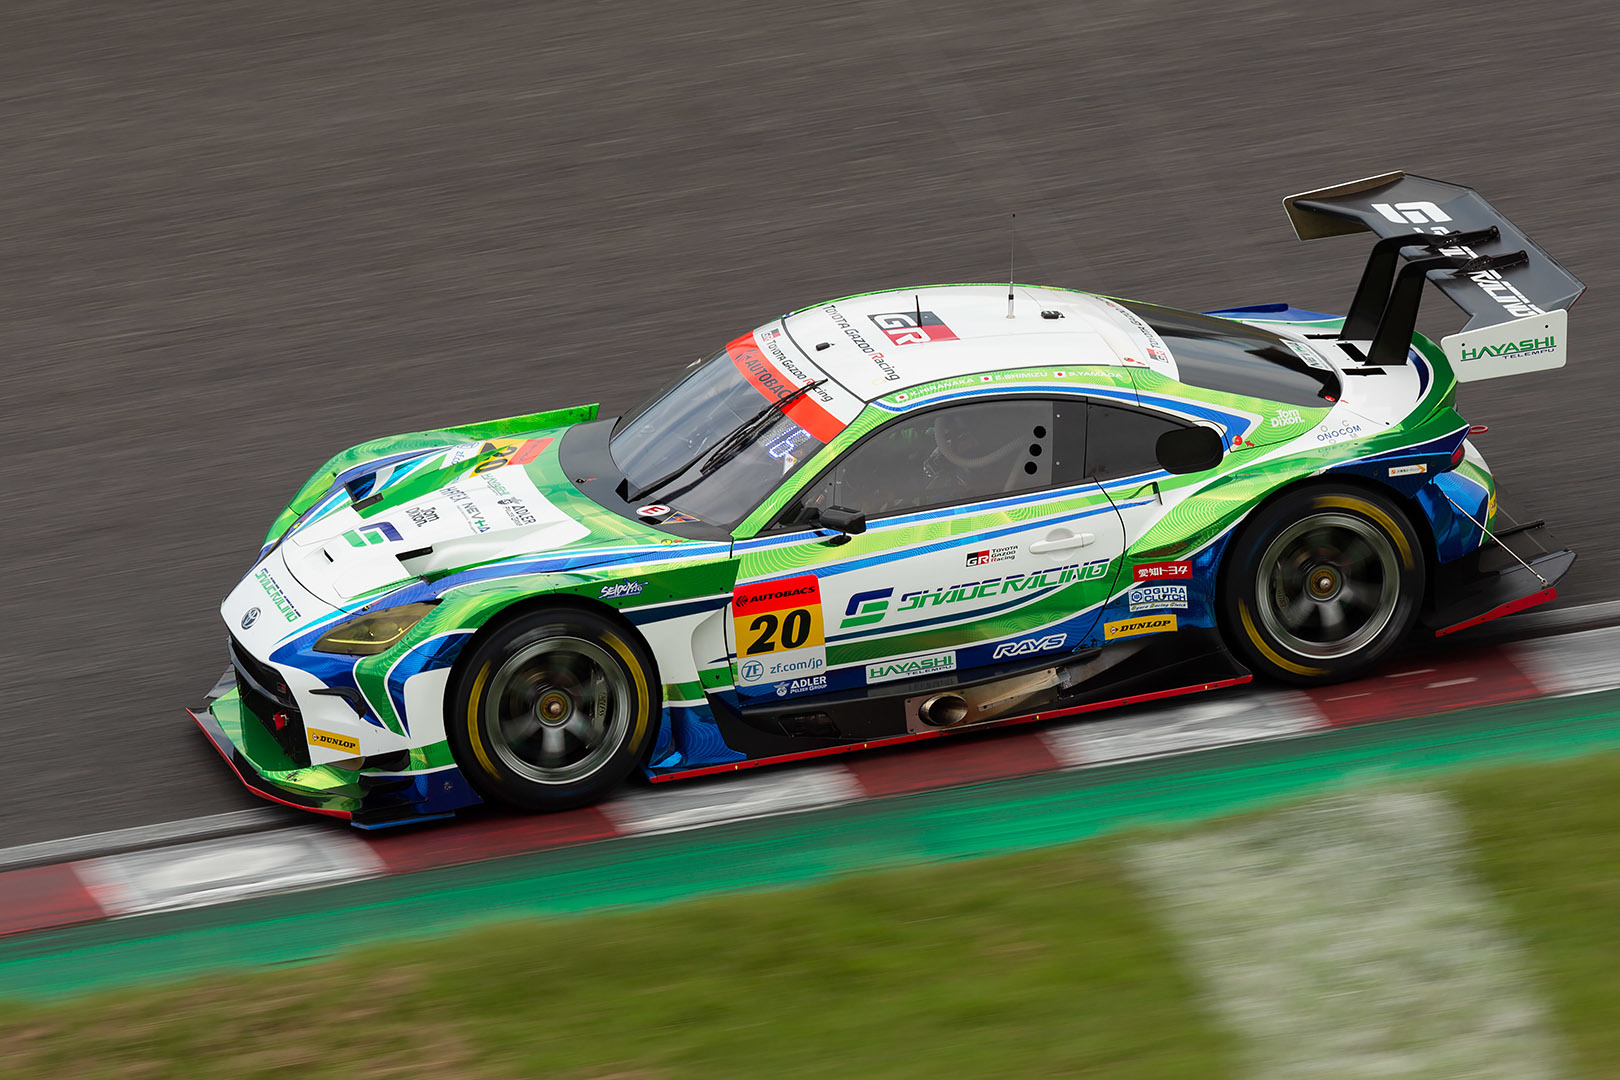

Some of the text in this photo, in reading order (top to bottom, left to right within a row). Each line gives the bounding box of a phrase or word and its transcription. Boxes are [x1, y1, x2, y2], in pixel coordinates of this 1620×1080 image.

[873, 313, 931, 346] GR
[823, 304, 900, 382] TOYOTA GAZOO Racing
[1461, 336, 1556, 361] HAYASHI
[767, 339, 783, 362] TOYOTA
[782, 357, 807, 382] GAZOO
[1502, 348, 1556, 360] TELEMPU
[745, 358, 793, 400] AUTOBAC
[1270, 416, 1305, 427] Dixon.
[1276, 409, 1300, 419] Tom
[1316, 425, 1361, 441] ONOCOM
[420, 506, 440, 522] Tom
[511, 505, 537, 525] ADLER
[991, 545, 1019, 553] TOYOTA
[991, 550, 1016, 558] GAZOO
[966, 553, 989, 567] GR
[991, 555, 1016, 563] Racing
[1138, 565, 1188, 578] 愛知トヨタ
[897, 557, 1111, 612] SHADE RACING
[1143, 587, 1186, 595] OGURA
[749, 586, 816, 604] AUTOBACS
[1144, 594, 1186, 602] CLUTCH
[746, 608, 812, 656] 20
[1119, 620, 1171, 632] DUNLOP
[993, 633, 1067, 660] RAYS
[770, 657, 823, 674] zf.com/jp
[870, 655, 952, 677] HAYASHI
[905, 665, 952, 676] TELEMPU
[790, 675, 827, 689] ADLER
[319, 735, 357, 749] DUNLOP
